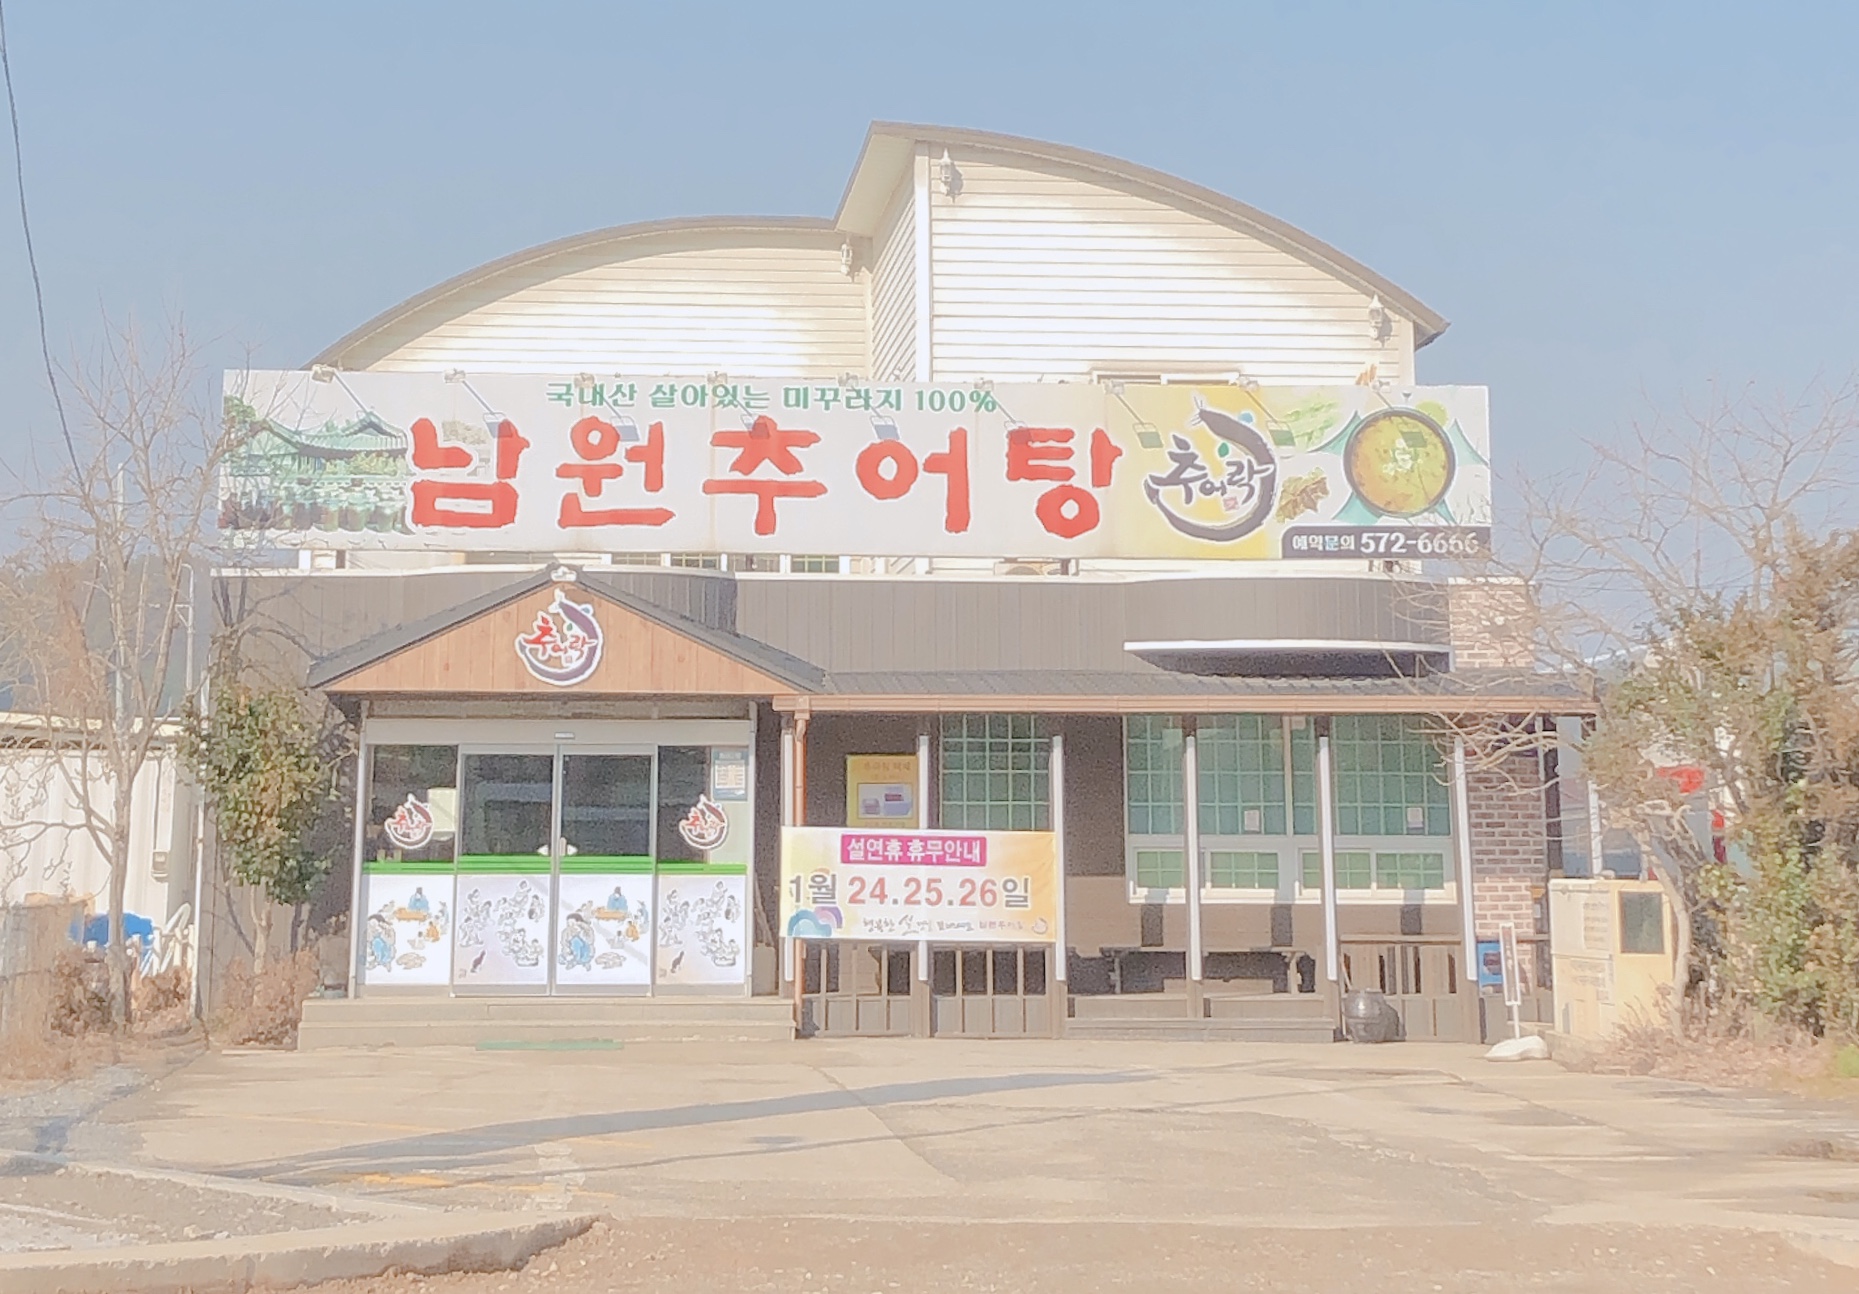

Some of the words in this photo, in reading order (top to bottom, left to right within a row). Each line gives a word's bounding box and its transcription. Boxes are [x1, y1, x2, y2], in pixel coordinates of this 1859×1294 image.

[545, 382, 638, 409] 국내산
[649, 383, 771, 410] 살아있는
[782, 387, 903, 412] 미꾸라지
[915, 389, 999, 413] 100%
[1148, 434, 1270, 505] 추어락
[1292, 534, 1355, 551] 예약문의
[1360, 531, 1480, 554] 572-6666
[523, 616, 596, 661] 추어락
[847, 838, 903, 862] 설연휴
[906, 839, 981, 863] 휴무안내
[789, 874, 838, 906] 1월
